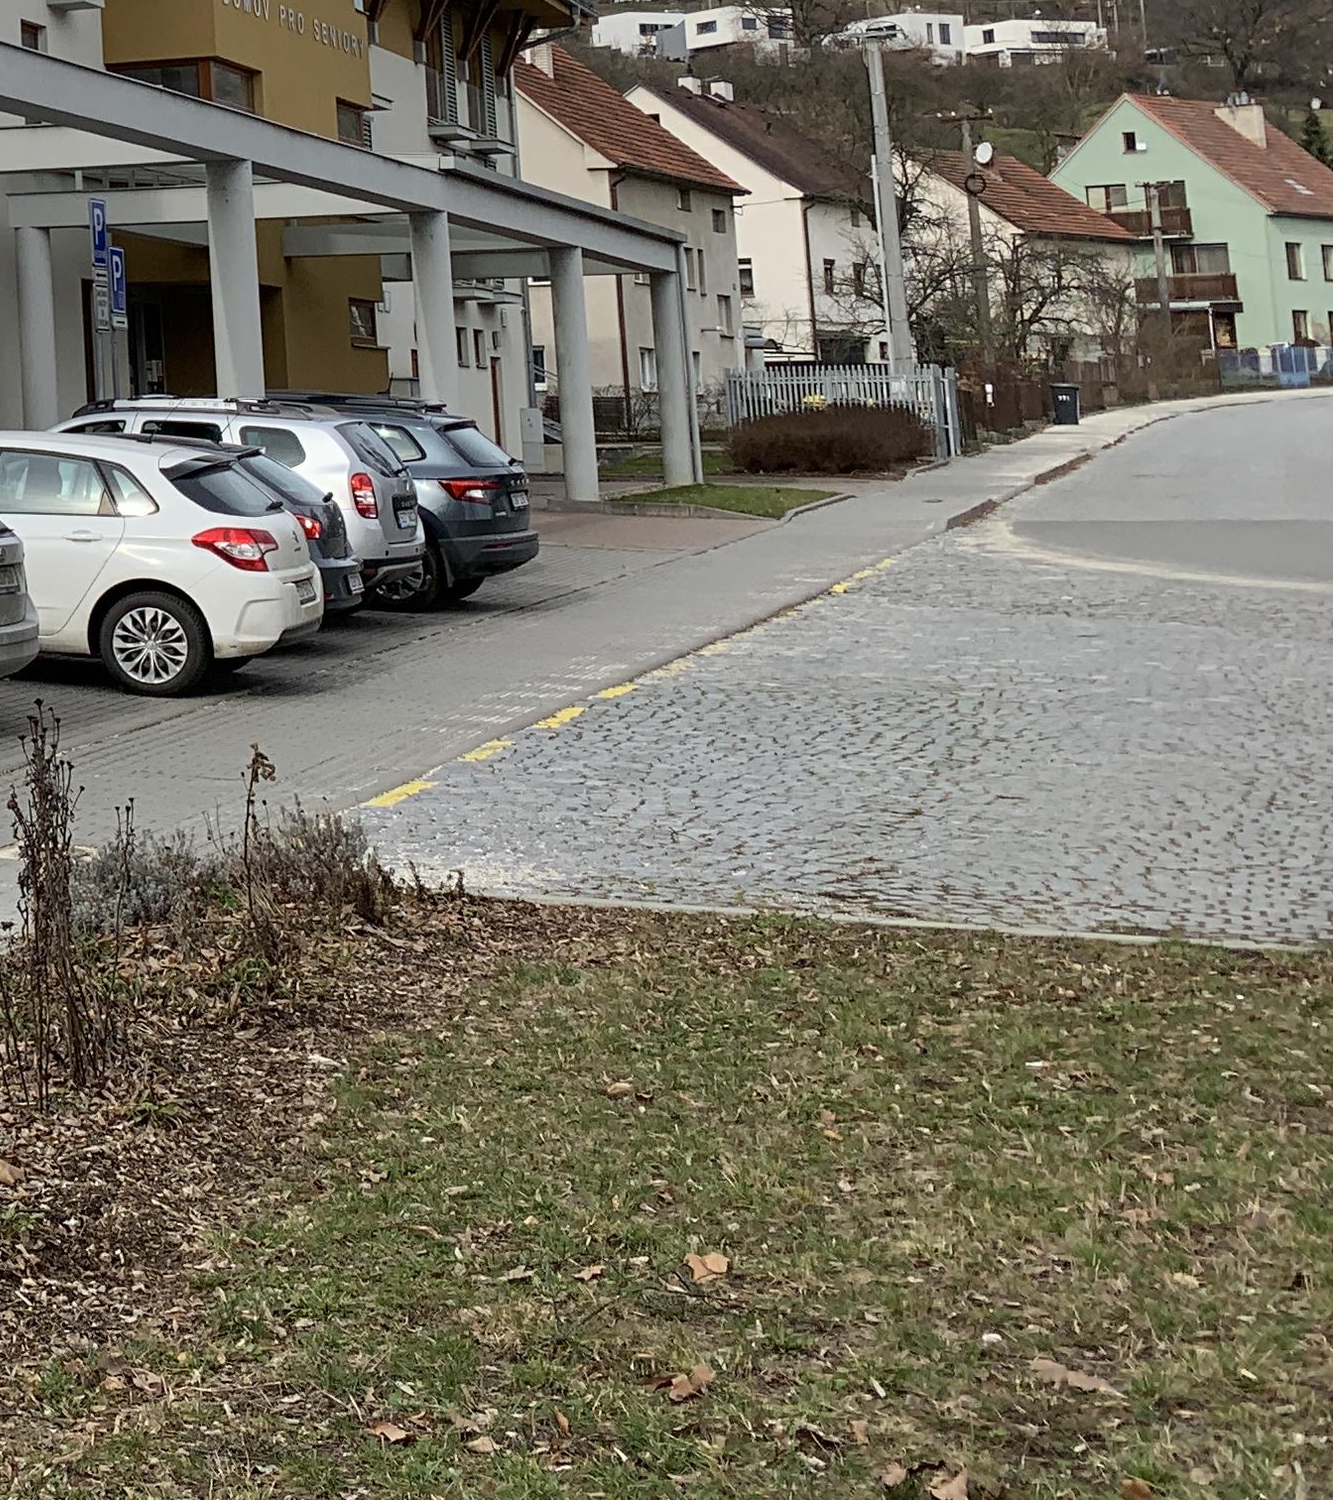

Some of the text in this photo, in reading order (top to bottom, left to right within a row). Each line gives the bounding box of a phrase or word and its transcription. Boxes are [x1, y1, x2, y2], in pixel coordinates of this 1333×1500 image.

[279, 5, 305, 34] PRO
[314, 19, 364, 59] SENIORY
[93, 207, 103, 245] P
[112, 254, 122, 291] P
